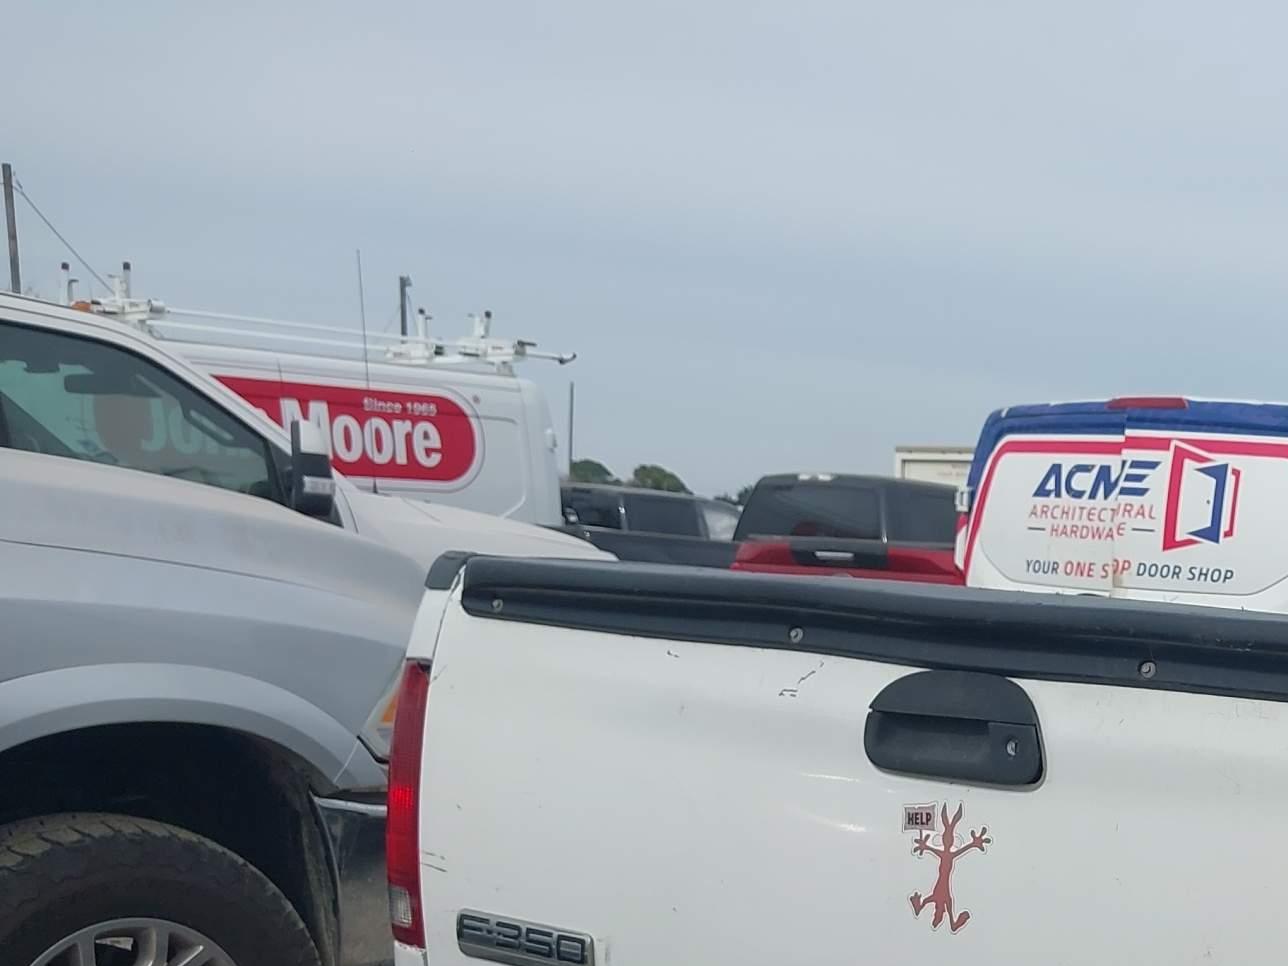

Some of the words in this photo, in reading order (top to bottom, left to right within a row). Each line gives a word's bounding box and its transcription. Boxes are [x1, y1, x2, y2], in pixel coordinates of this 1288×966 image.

[1028, 502, 1157, 523] ARCHITECTRAL
[1049, 522, 1127, 541] HARDWAE
[1026, 558, 1060, 576] YOUR
[1064, 559, 1096, 578] ONE
[1136, 561, 1182, 580] DOOR
[1186, 566, 1235, 584] SHOP
[907, 811, 932, 826] HELP
[458, 913, 586, 965] F-350
